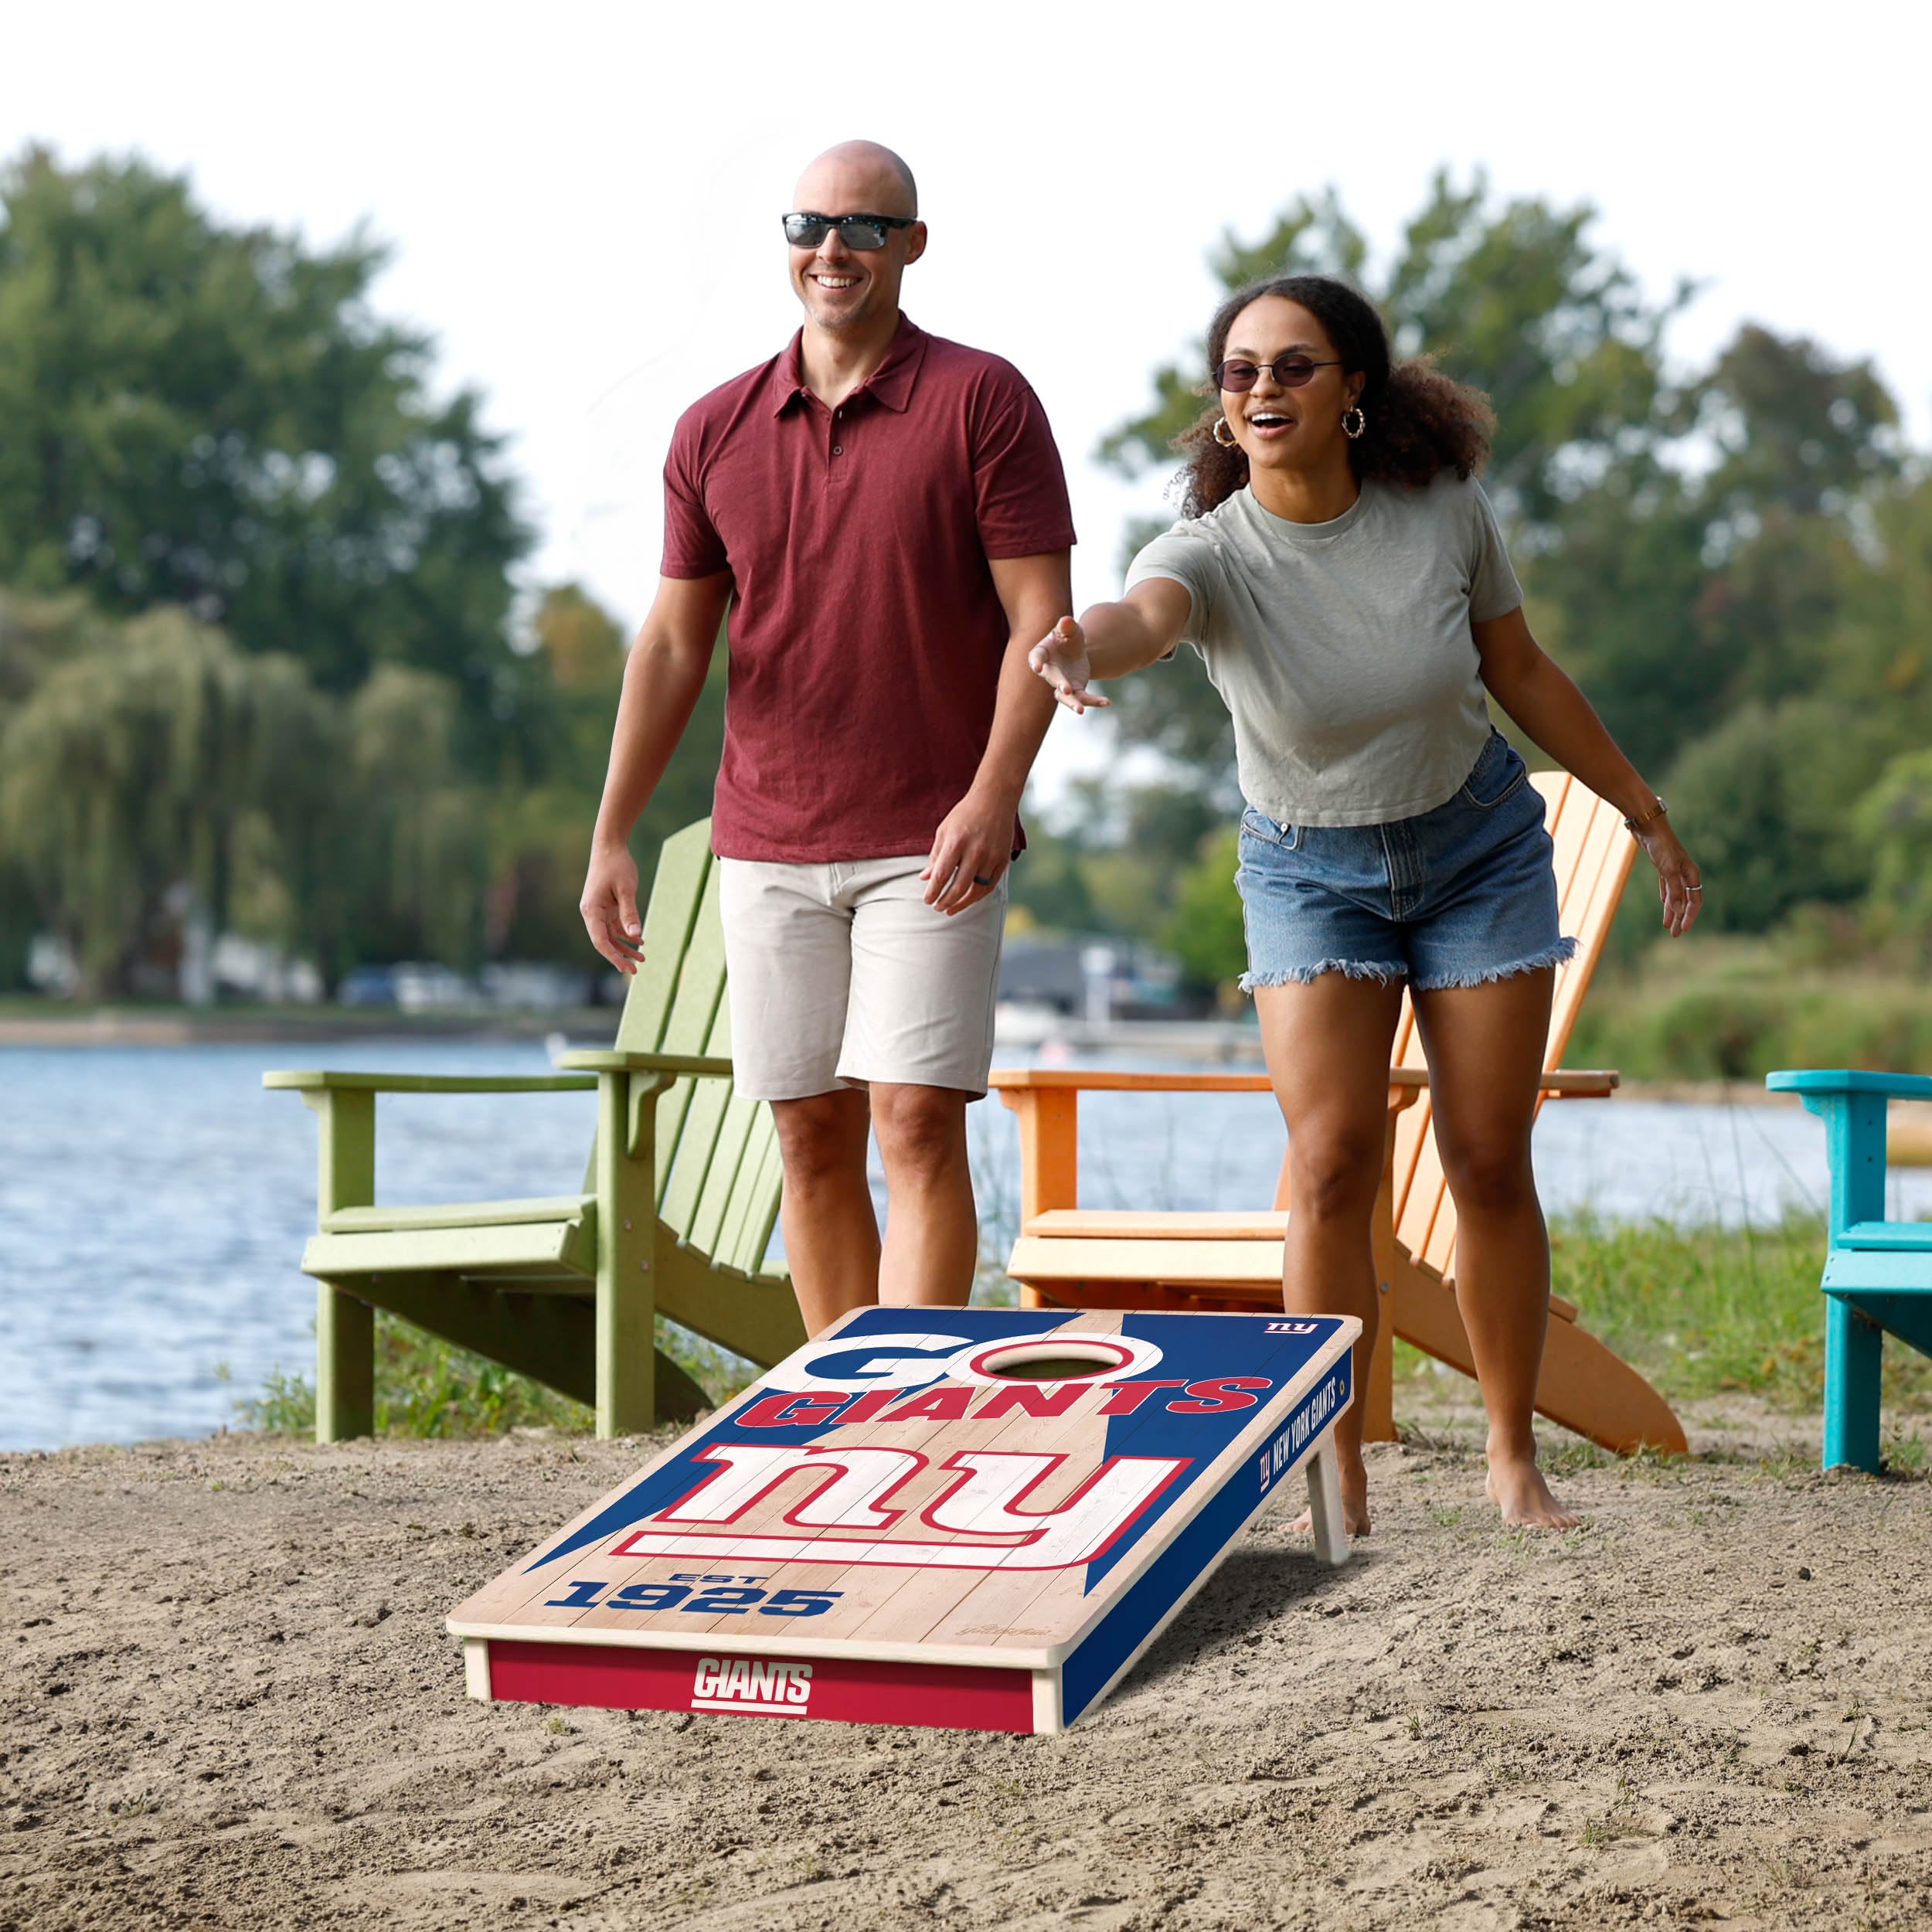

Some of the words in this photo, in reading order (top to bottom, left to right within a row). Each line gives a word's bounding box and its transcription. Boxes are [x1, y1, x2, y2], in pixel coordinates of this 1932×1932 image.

[757, 1332, 1163, 1393] GO
[734, 1376, 1273, 1427] GIANTS
[1260, 1449, 1270, 1493] ny
[1273, 1426, 1290, 1475] NEW
[1291, 1404, 1311, 1454] YORK
[1311, 1376, 1335, 1431] GIANTS
[607, 1442, 1196, 1570] ny
[543, 1580, 845, 1617] 1925
[668, 1573, 770, 1584] EST
[693, 1658, 813, 1704] GIANTS
